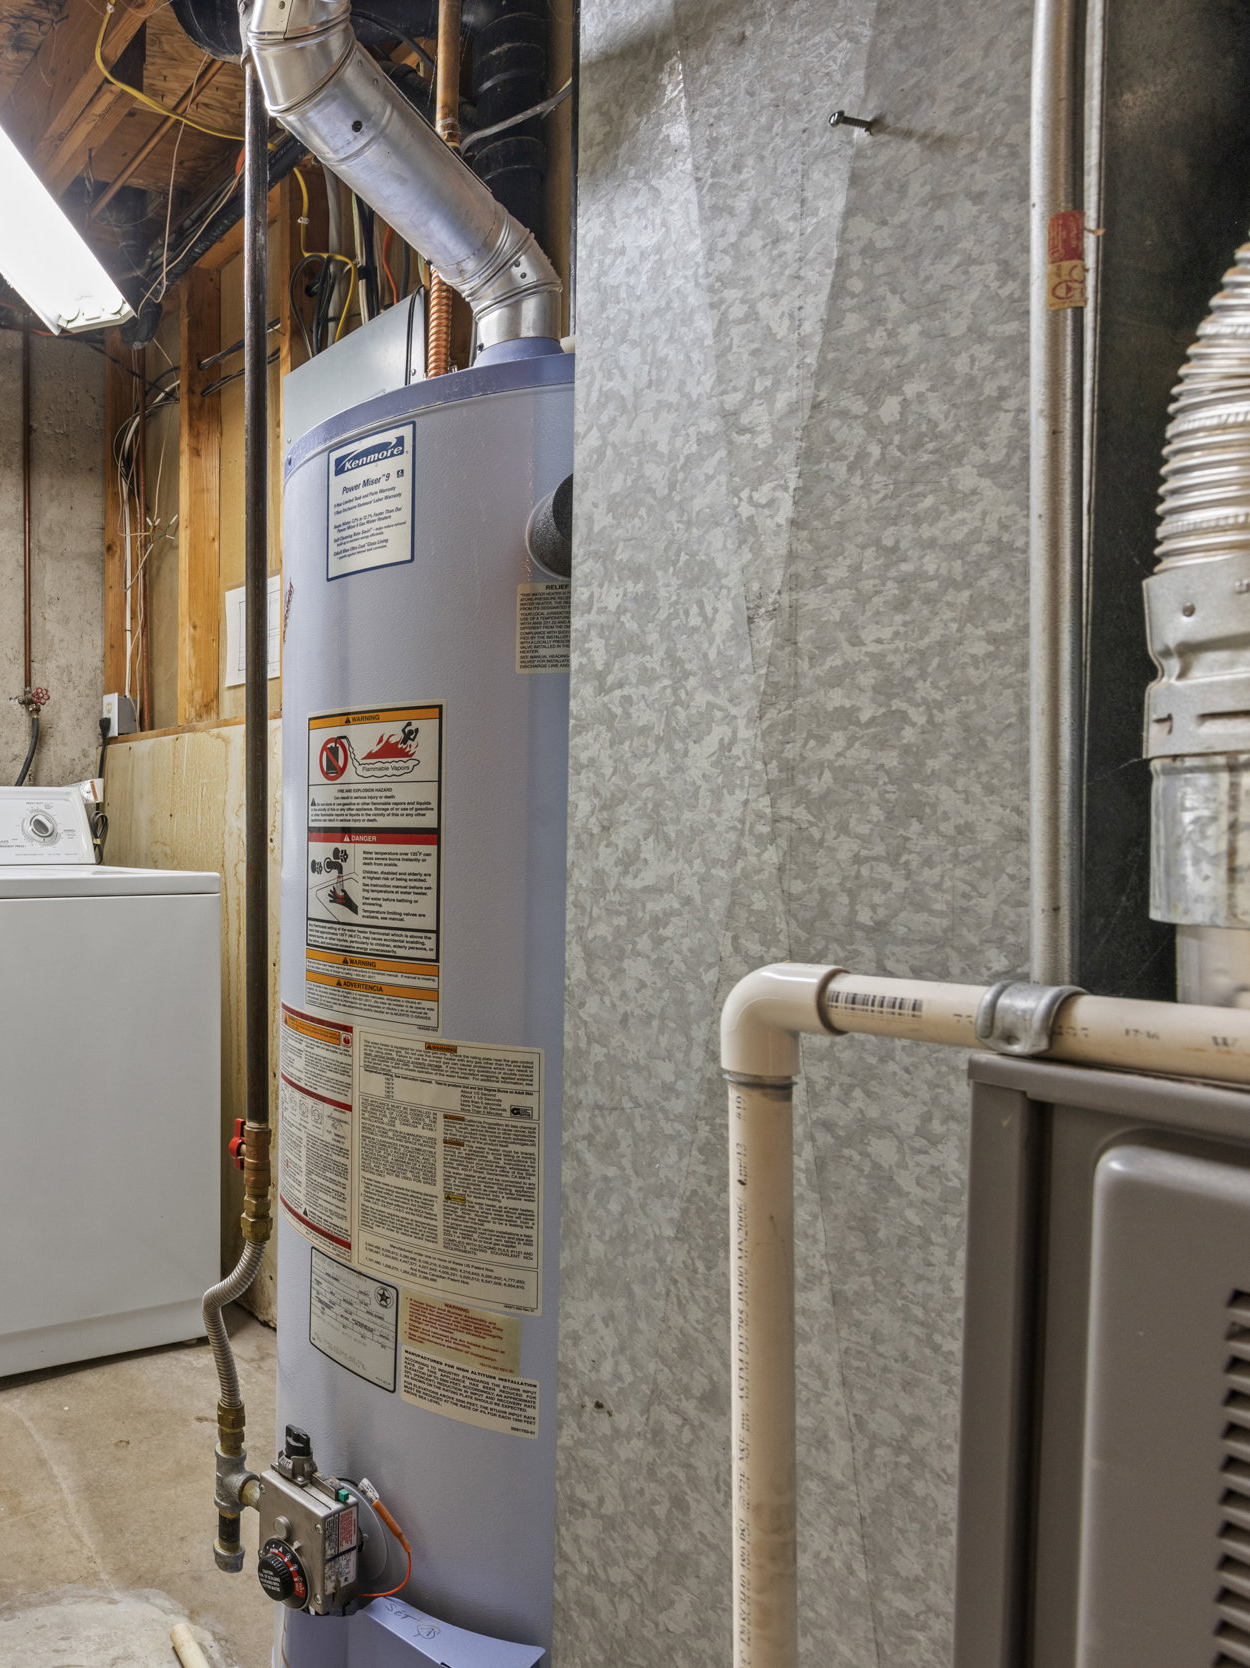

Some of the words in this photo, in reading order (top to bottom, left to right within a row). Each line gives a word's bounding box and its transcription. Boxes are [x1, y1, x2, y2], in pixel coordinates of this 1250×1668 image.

[345, 446, 402, 471] Kenmore
[342, 484, 361, 495] Power
[348, 958, 376, 967] WARNING
[343, 981, 383, 992] ADVERTENCIA
[444, 1303, 469, 1313] WARNING
[471, 1371, 496, 1380] ALTITUDE
[498, 1378, 537, 1388] INSTALLATION
[385, 1603, 422, 1622] SET
